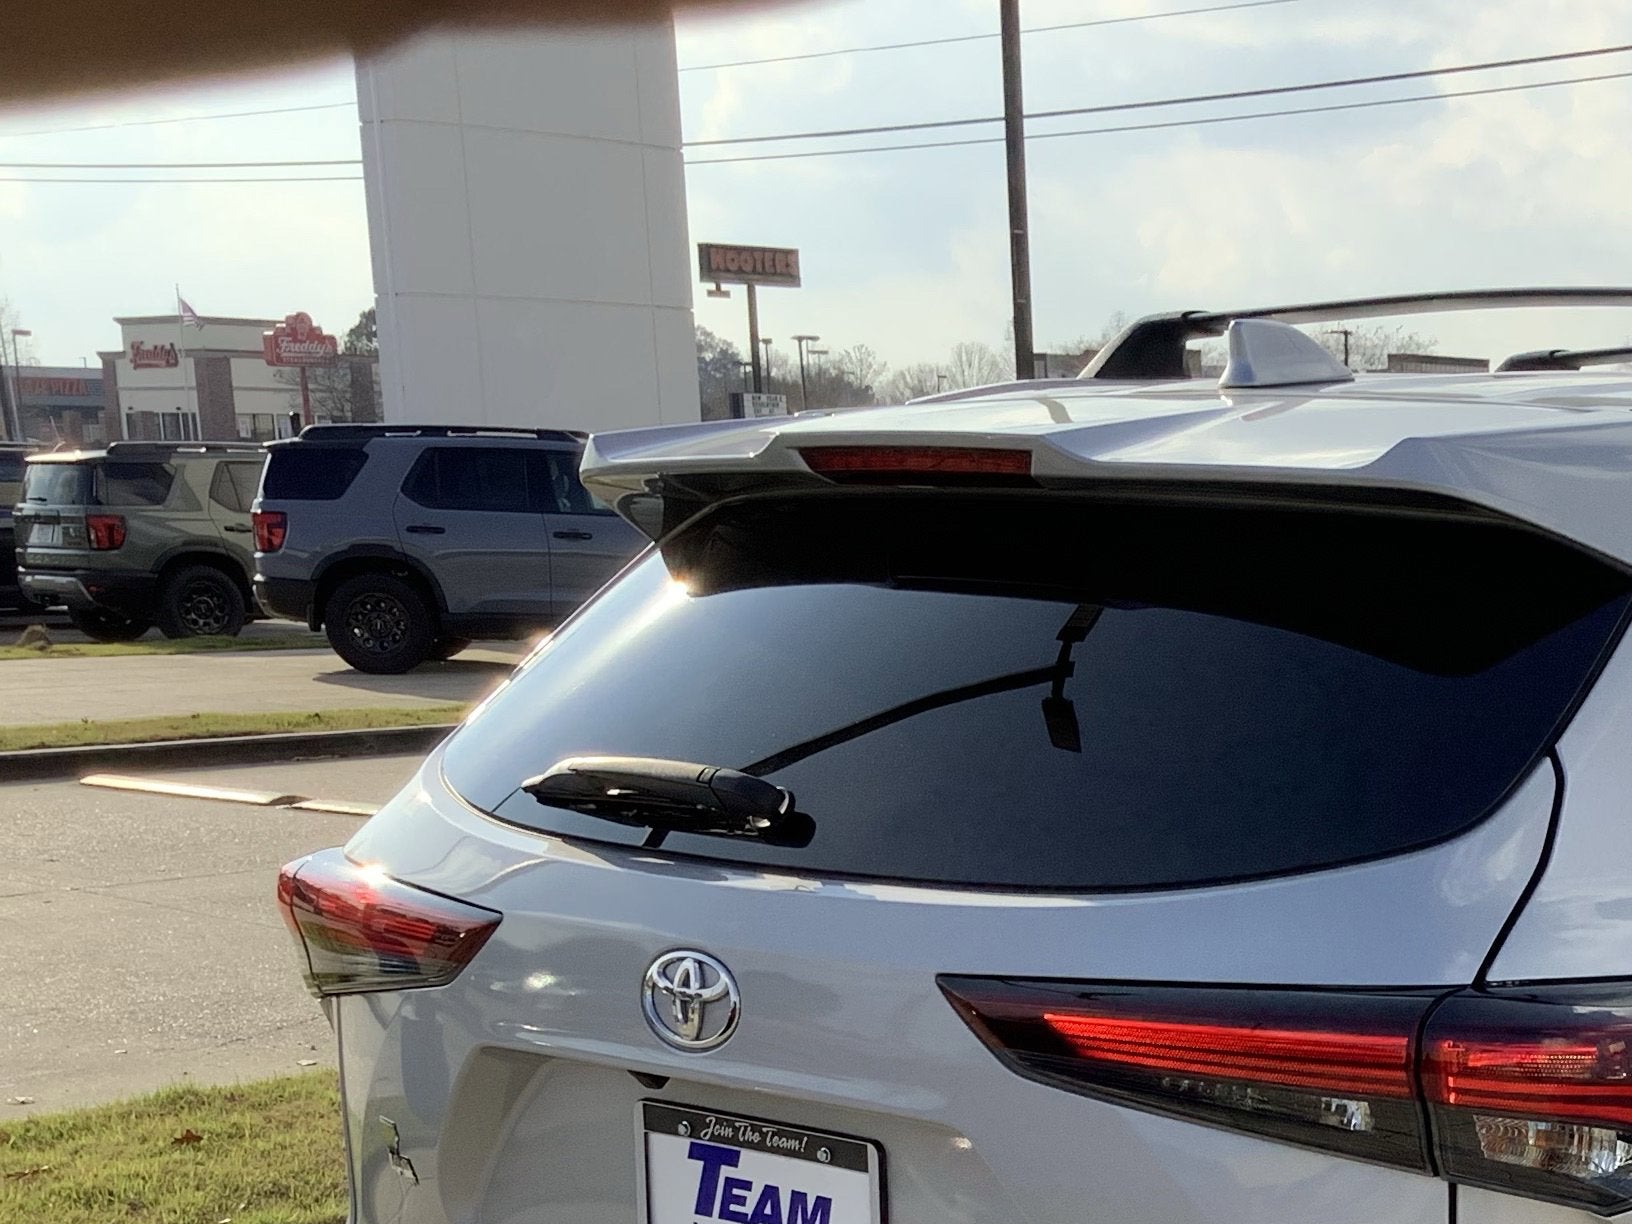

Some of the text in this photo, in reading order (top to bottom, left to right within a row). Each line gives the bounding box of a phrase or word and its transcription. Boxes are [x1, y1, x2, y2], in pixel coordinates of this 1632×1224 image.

[710, 247, 798, 276] HOOTERS
[275, 336, 333, 358] Freddy's
[700, 1116, 808, 1152] Join The Team!
